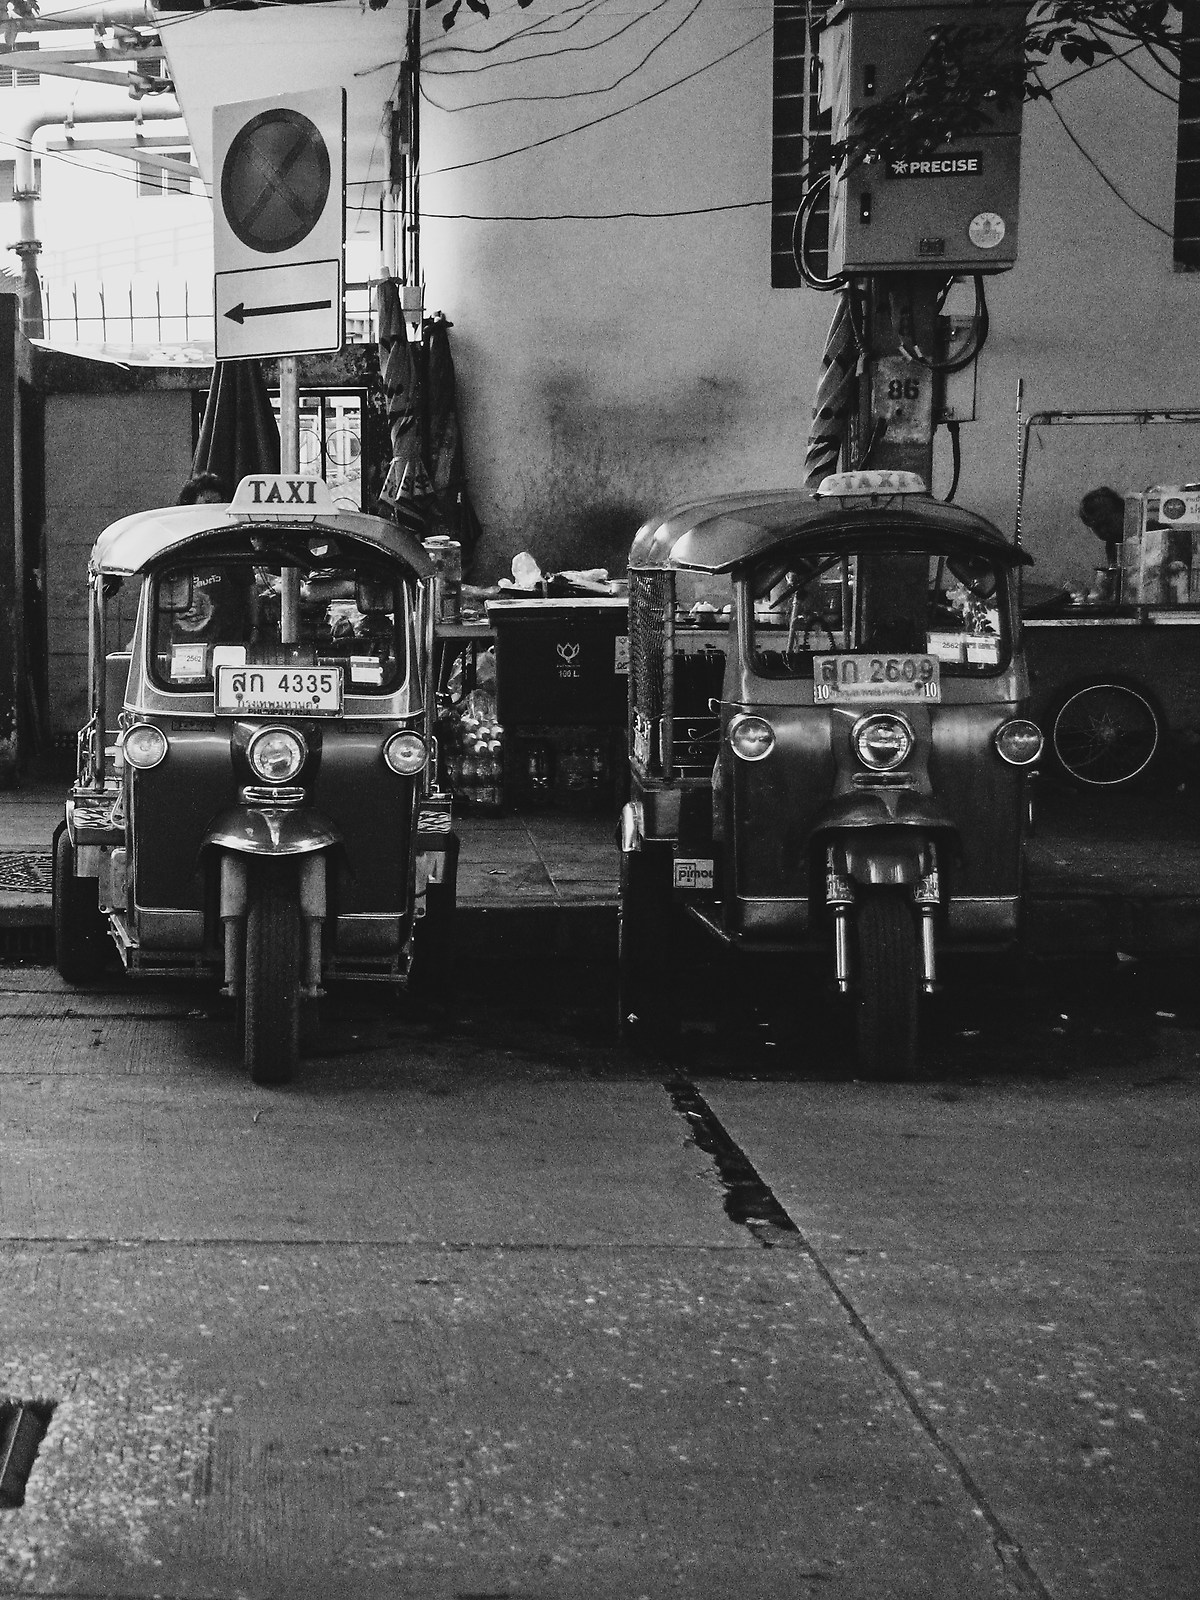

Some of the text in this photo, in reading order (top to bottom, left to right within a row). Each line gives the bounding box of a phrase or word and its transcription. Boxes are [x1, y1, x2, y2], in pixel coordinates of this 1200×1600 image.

[909, 158, 978, 174] PRECISE
[887, 378, 920, 401] 86
[841, 473, 908, 490] TAXI
[247, 480, 318, 504] TAXI
[869, 658, 934, 683] 2609
[231, 672, 332, 694] สก 4335
[817, 684, 830, 700] 10
[924, 681, 937, 698] 10
